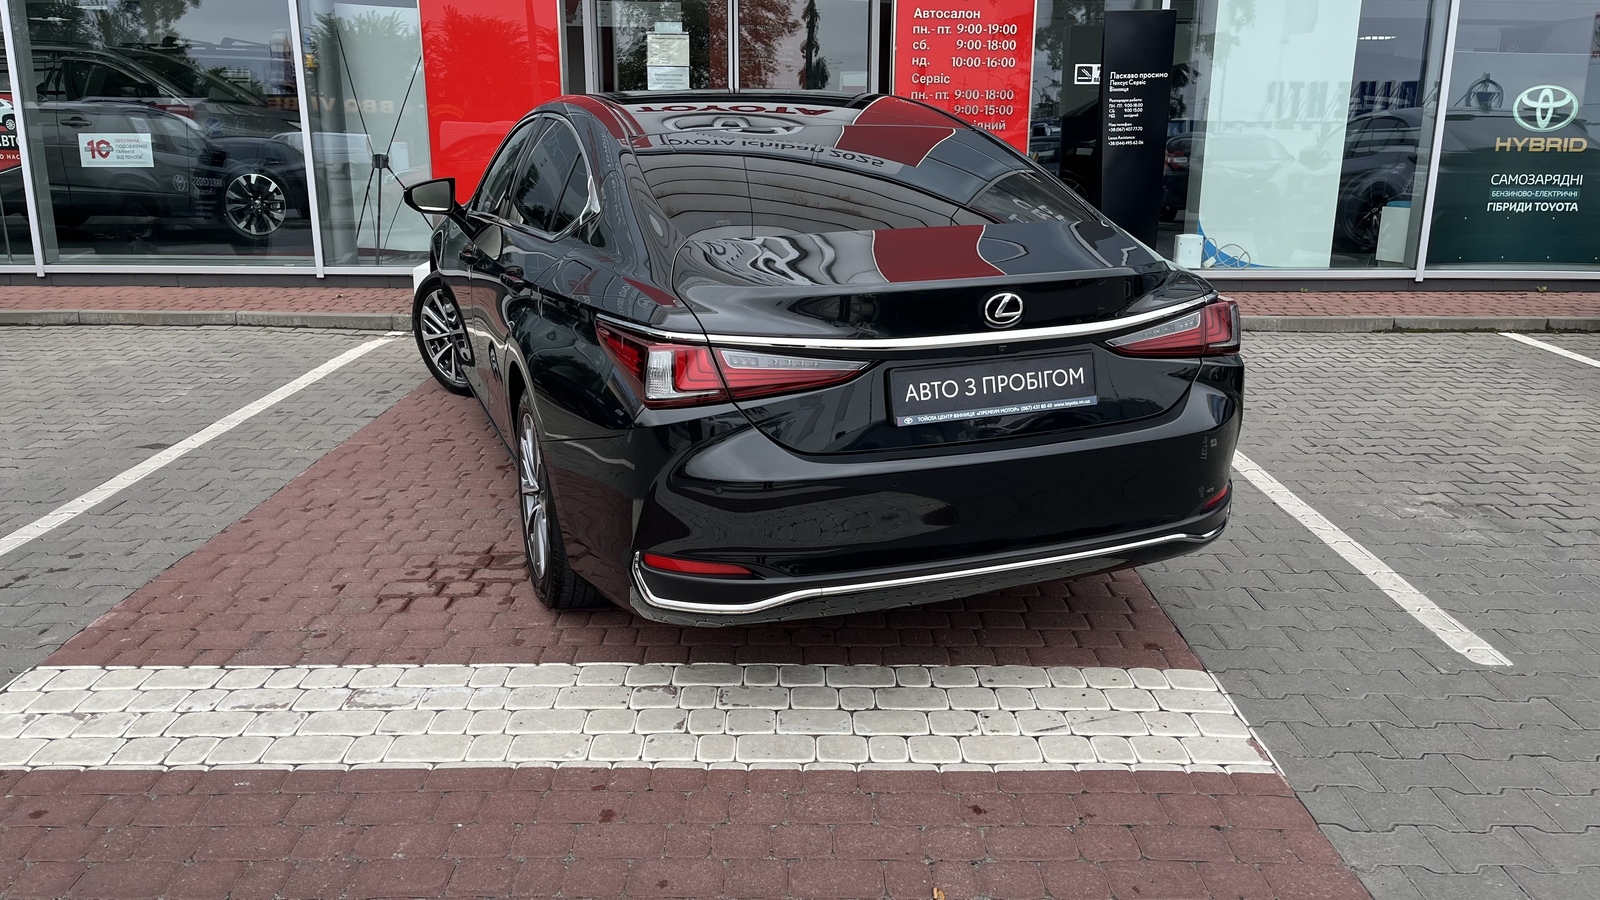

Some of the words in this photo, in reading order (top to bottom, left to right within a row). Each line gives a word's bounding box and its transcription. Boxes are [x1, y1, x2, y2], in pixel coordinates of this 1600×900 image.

[914, 7, 981, 19] Автосалон
[956, 24, 1018, 35] 9:00-19:00
[912, 39, 930, 50] сб.
[956, 40, 1017, 51] 9:00-18:00
[911, 57, 930, 67] нд.
[951, 57, 1016, 68] 10:00-16:00
[911, 72, 951, 86] Сервіс
[1110, 71, 1139, 79] Ласкаво
[1139, 72, 1169, 80] просимо
[954, 89, 1014, 100] 9:00-18:00
[953, 104, 1014, 116] 9:00-15:00
[1494, 137, 1588, 152] HYBRID
[1490, 174, 1584, 187] САМОЗАРЯДНІ
[1491, 190, 1578, 198] БЕНЗИНОВО-ЕЛЕКТРИЧНІ
[1486, 202, 1532, 213] ГІБРИДИ
[1534, 202, 1579, 212] TOYOTA
[905, 379, 959, 402] АВТО
[964, 378, 977, 396] З
[982, 367, 1085, 395] ПРОБІГОМ
